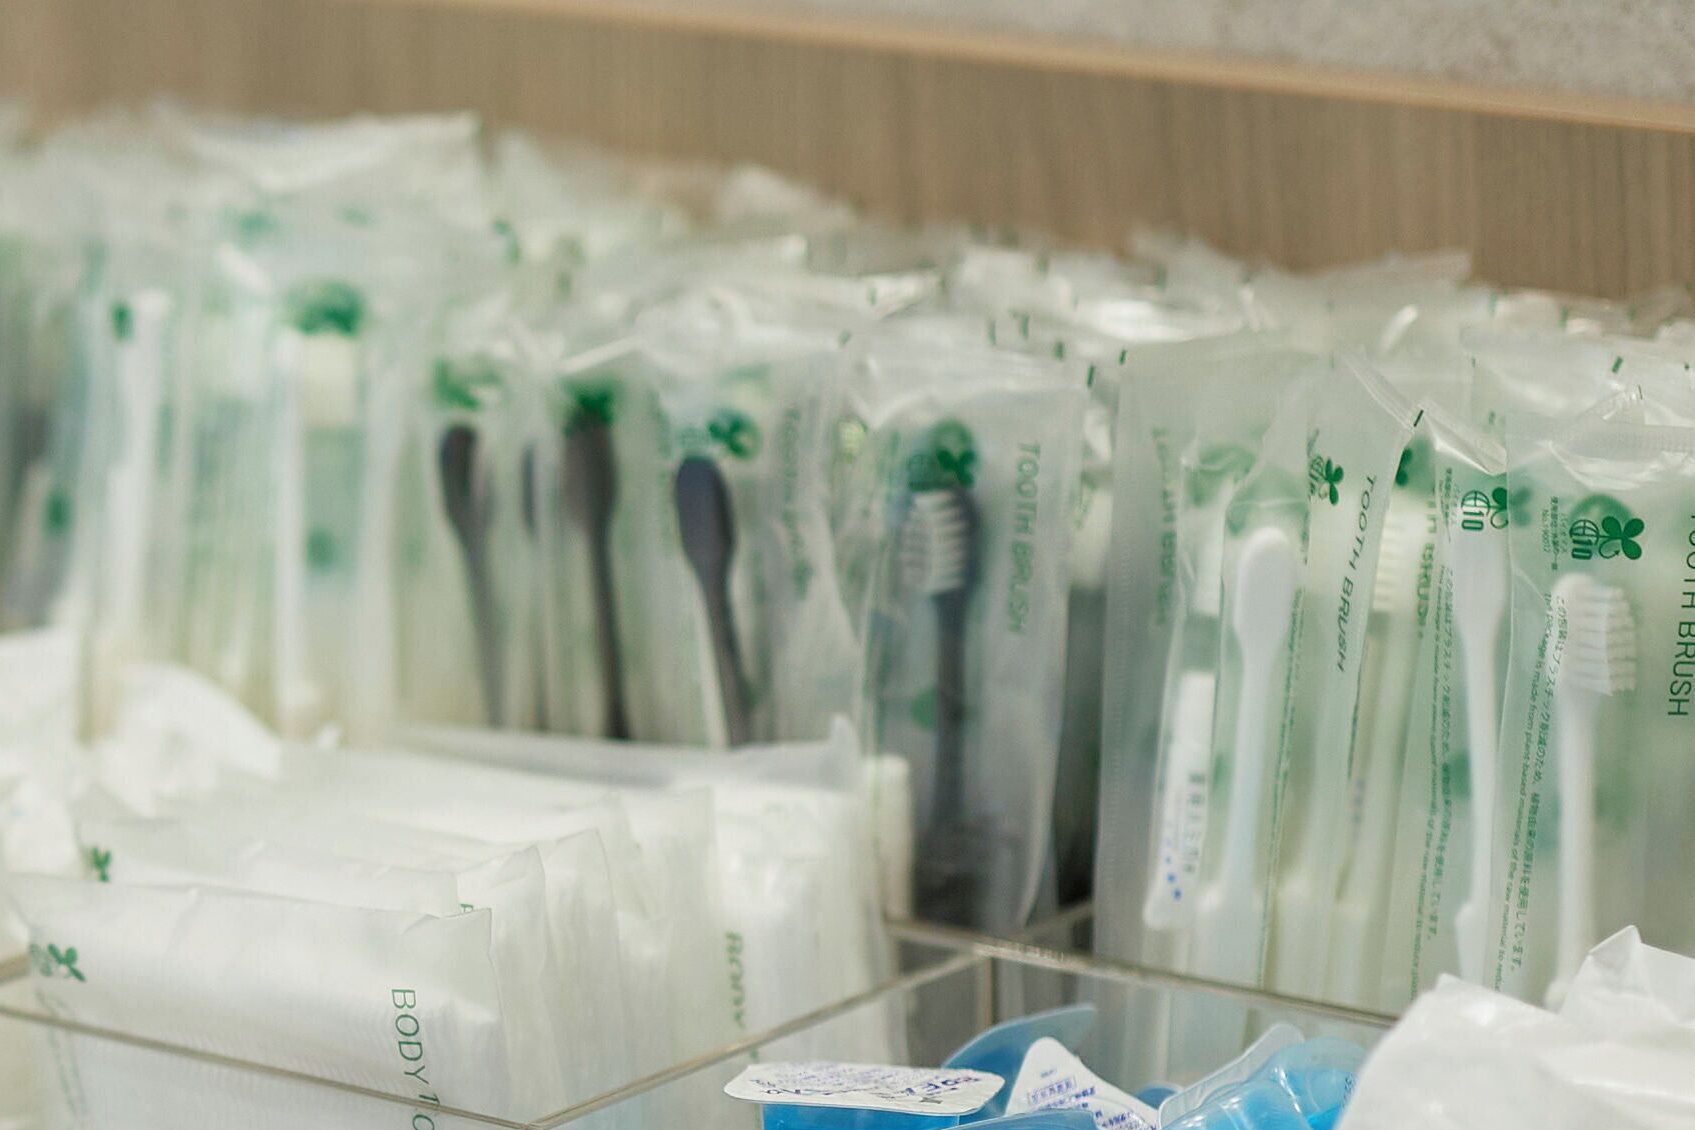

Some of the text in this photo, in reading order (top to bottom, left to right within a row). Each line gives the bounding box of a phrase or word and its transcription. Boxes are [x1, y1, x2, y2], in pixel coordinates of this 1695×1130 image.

[1336, 474, 1377, 672] TOOTH BRUSH
[1667, 622, 1695, 716] BRUSH
[390, 988, 428, 1085] BODY
